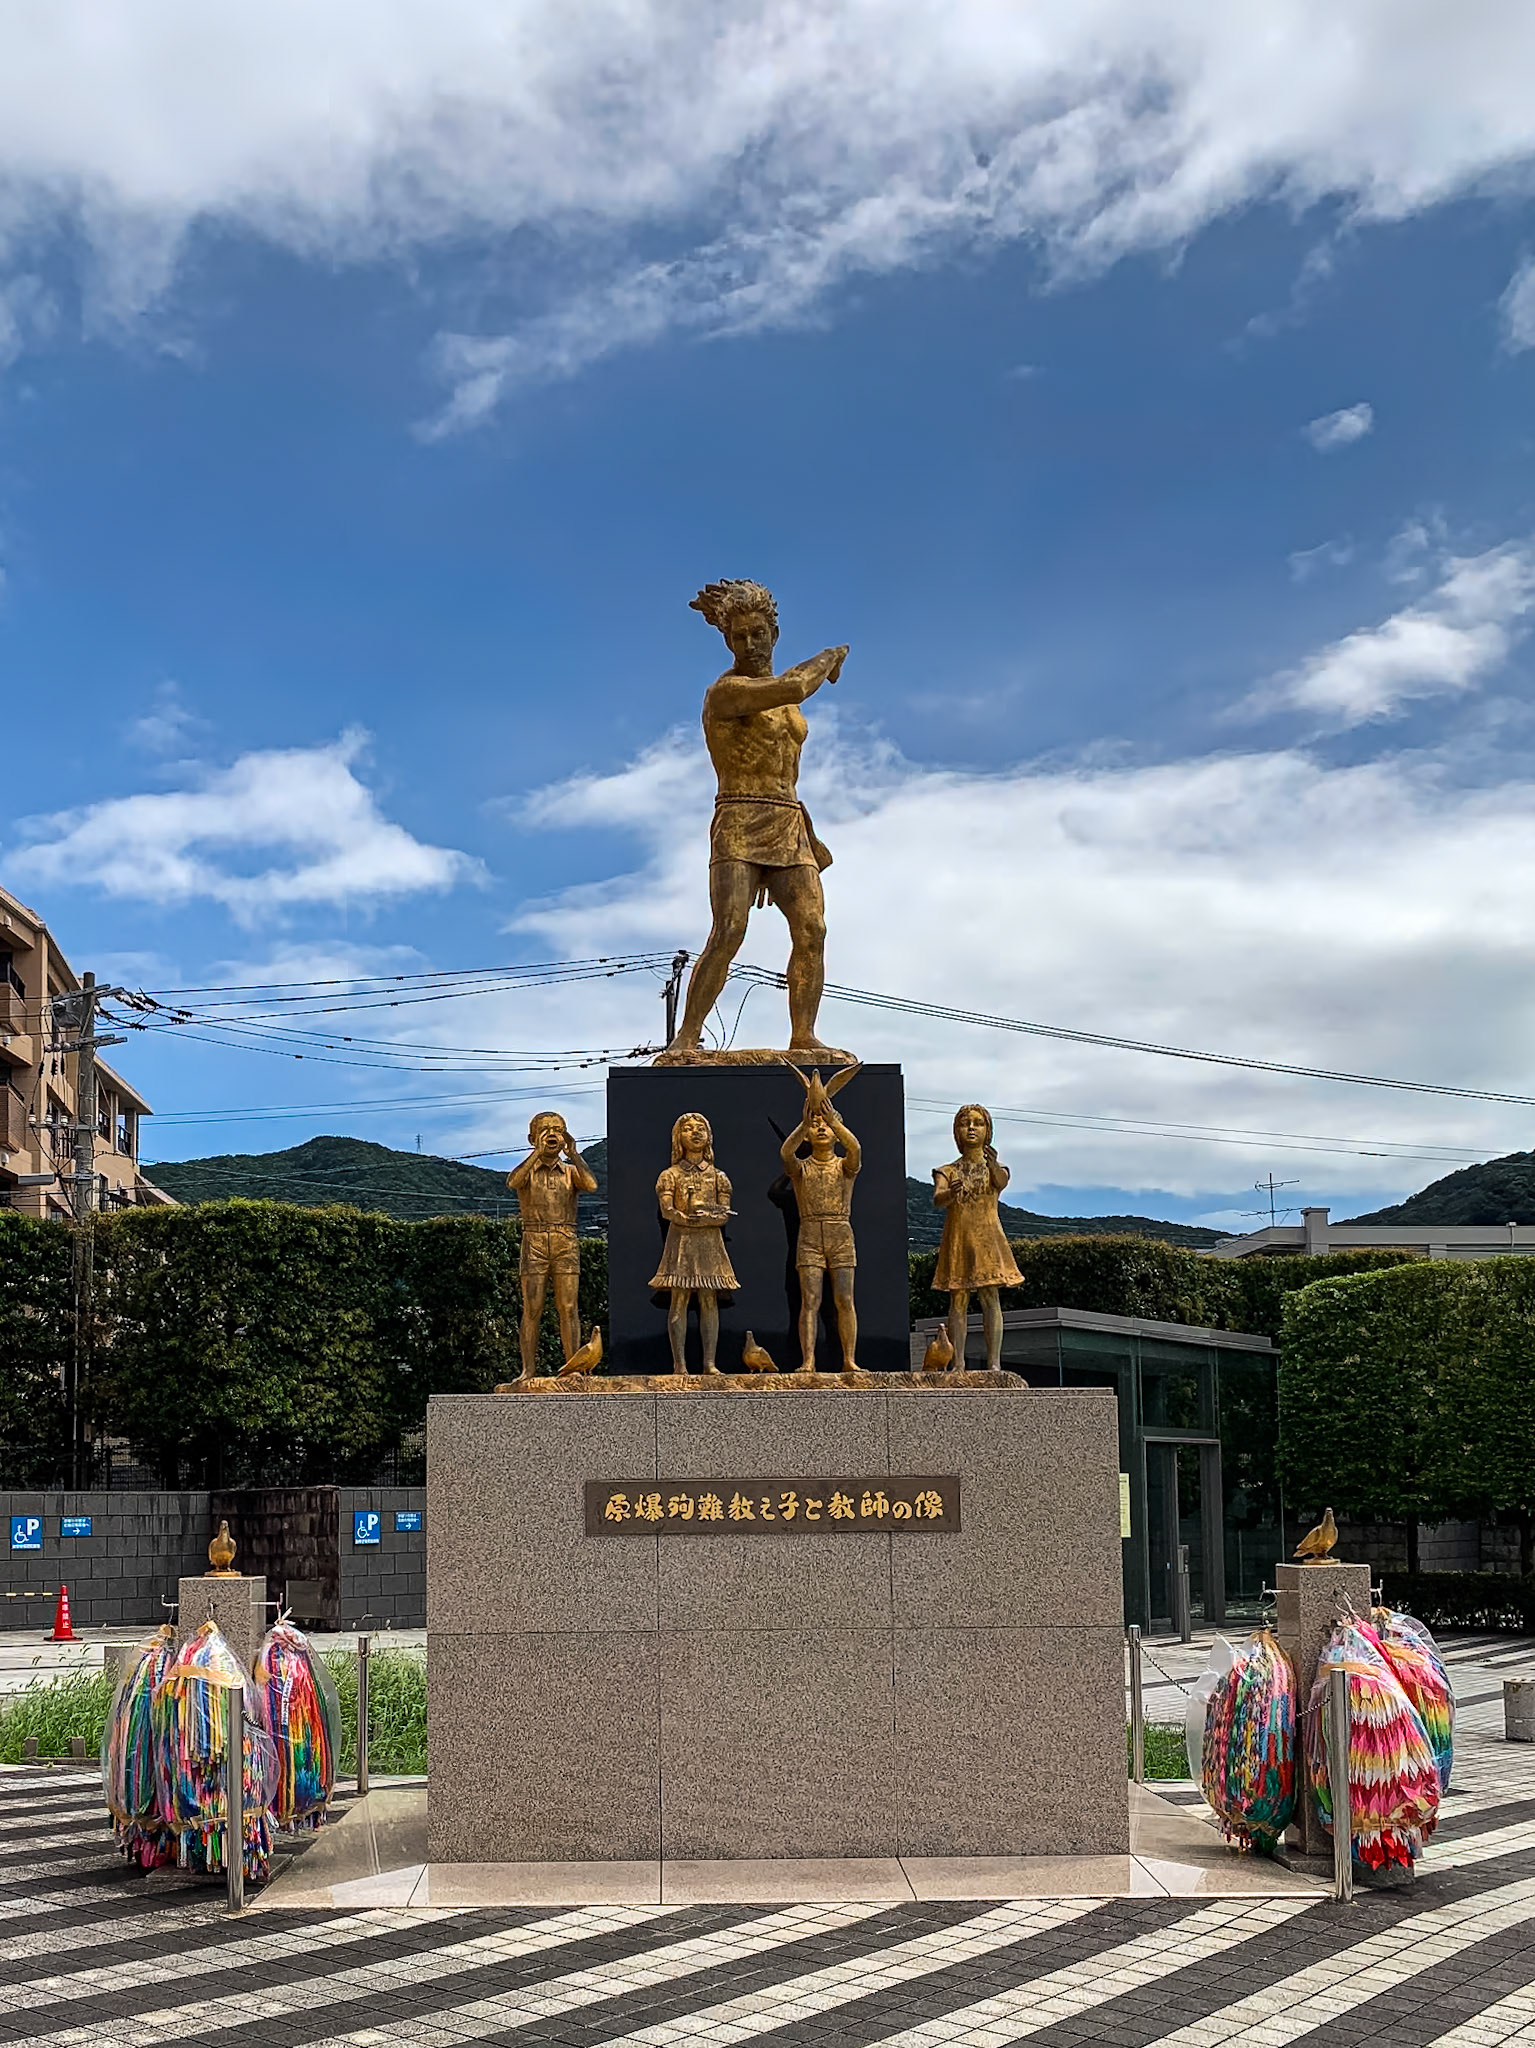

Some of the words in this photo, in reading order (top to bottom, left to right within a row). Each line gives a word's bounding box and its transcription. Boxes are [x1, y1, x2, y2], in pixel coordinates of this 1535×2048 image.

[604, 1490, 944, 1522] 原爆殉難教え子と教師の像
[27, 1519, 39, 1535] P
[368, 1514, 378, 1530] P
